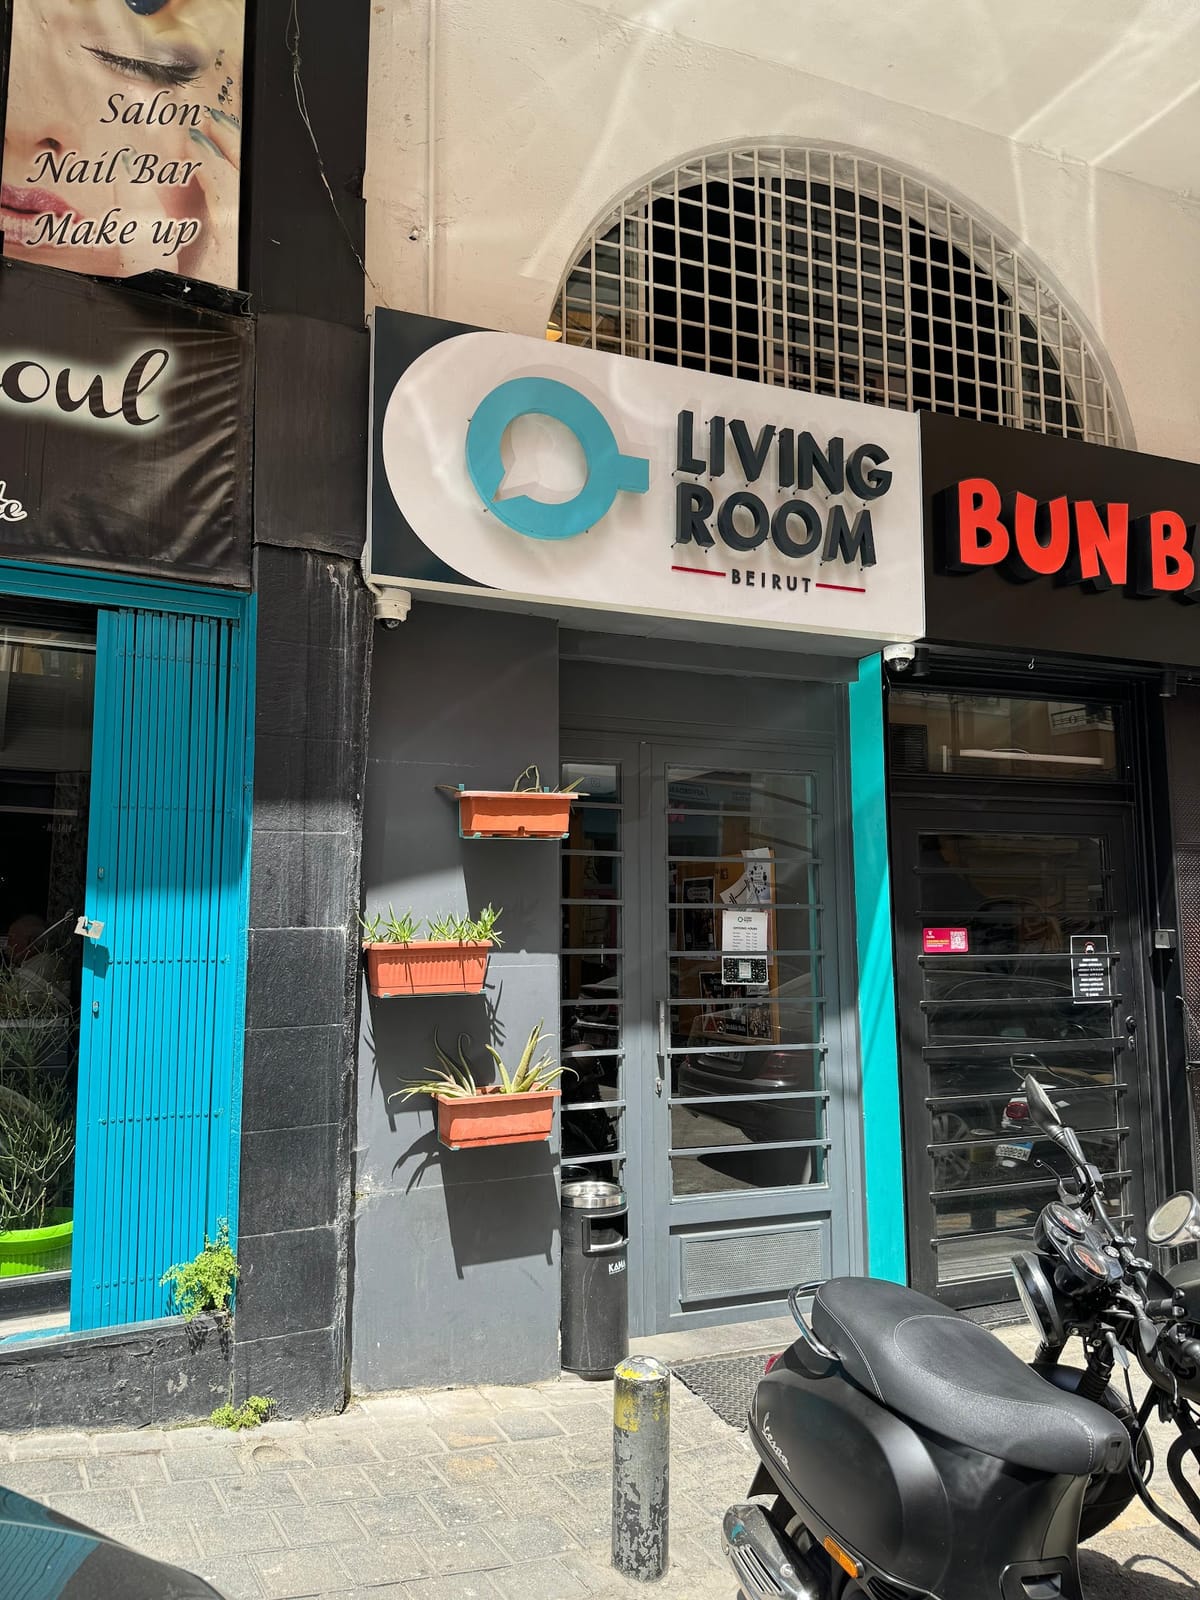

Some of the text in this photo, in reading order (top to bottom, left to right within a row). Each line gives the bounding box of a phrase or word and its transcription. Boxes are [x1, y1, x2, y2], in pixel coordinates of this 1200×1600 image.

[99, 91, 202, 128] Salon
[26, 148, 203, 187] Nail Bar
[25, 207, 200, 257] Make up
[0, 348, 169, 426] oul
[675, 408, 893, 502] LIVING
[674, 481, 879, 570] ROOM
[952, 477, 1199, 593] BUN B
[730, 567, 813, 594] BEIRUT
